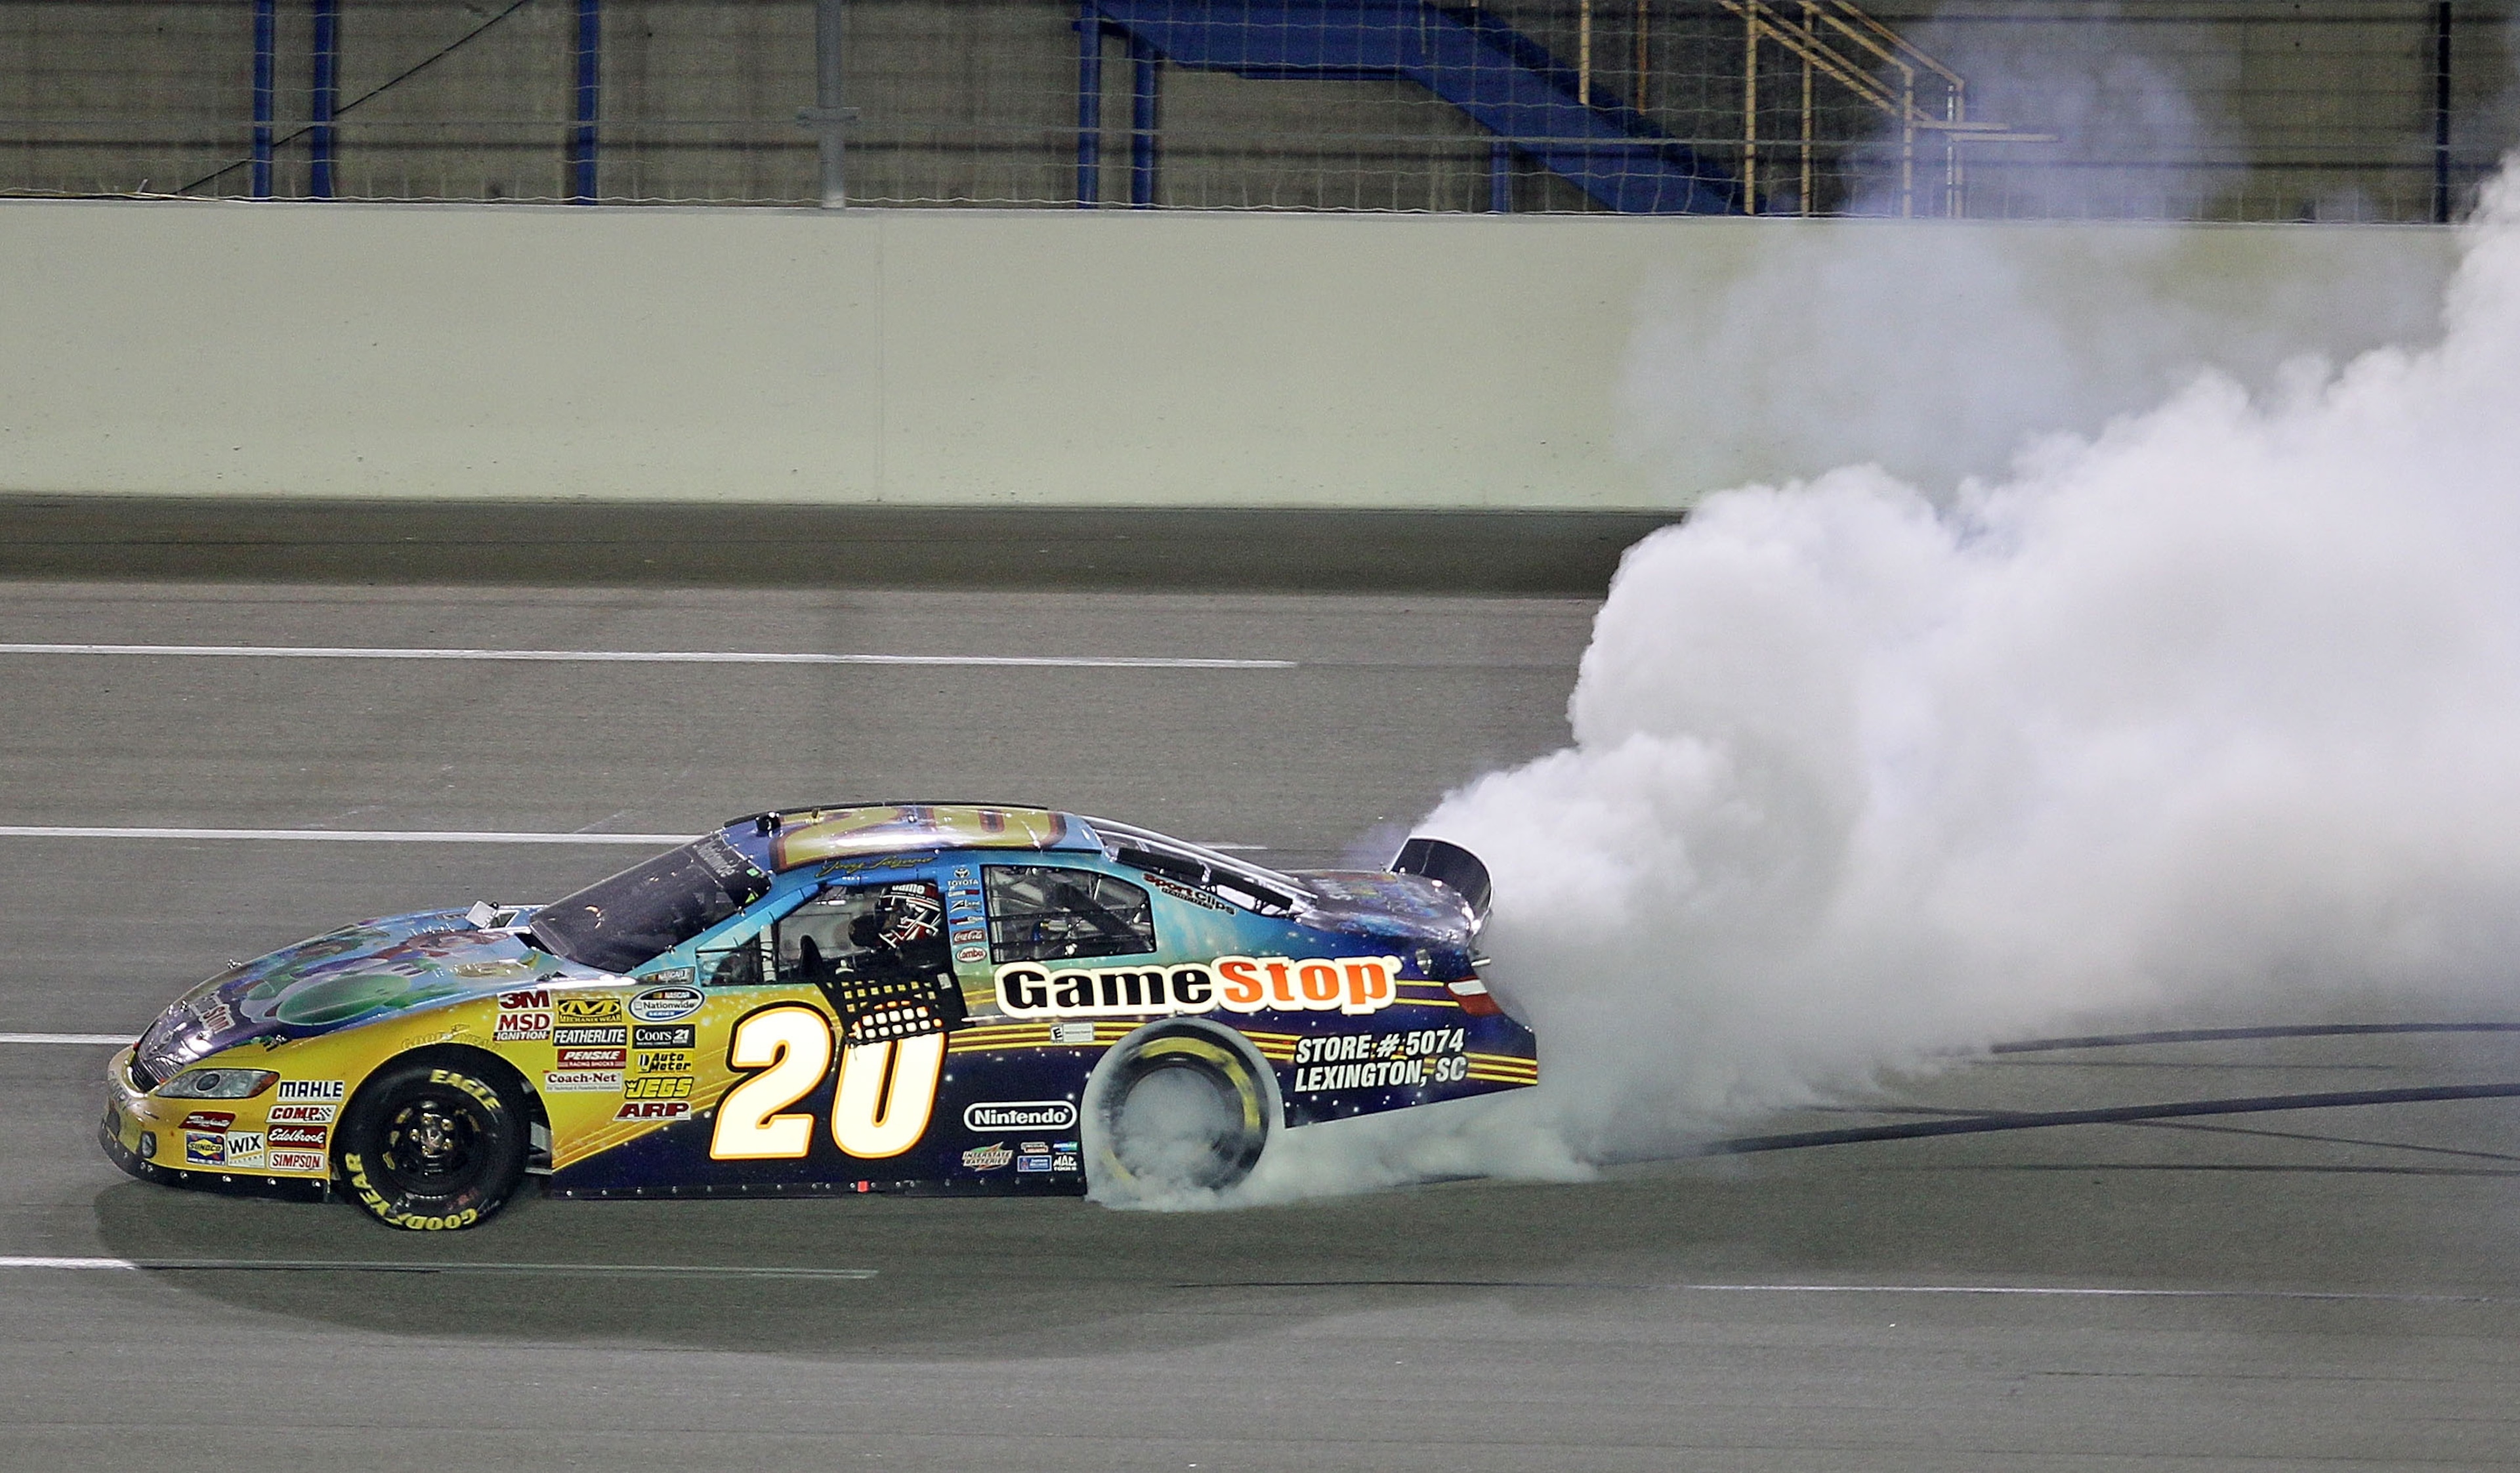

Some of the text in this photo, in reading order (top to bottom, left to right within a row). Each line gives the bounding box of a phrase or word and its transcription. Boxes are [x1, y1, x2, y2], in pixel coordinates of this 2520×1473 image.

[1143, 873, 1235, 916] Sport Clips
[998, 958, 1394, 1014] GameStop
[499, 990, 550, 1009] 3M
[499, 1014, 550, 1031] MSD
[497, 1031, 547, 1040] IGNITION
[554, 1029, 625, 1044] FEATHERLITE
[635, 1029, 690, 1042] Coors 21
[1053, 1027, 1063, 1039] E
[1296, 1028, 1465, 1063] STORE # 5074
[564, 1051, 621, 1060] PENSKE
[652, 1052, 685, 1061] Auto
[650, 1062, 692, 1071] Meter
[1295, 1056, 1467, 1092] LEXINGTON, SC
[547, 1072, 617, 1083] Coach-Net
[709, 1005, 947, 1161] 20
[279, 1081, 343, 1098] MAHLE
[430, 1069, 502, 1112] EAGLE
[626, 1077, 694, 1099] JEGS
[271, 1107, 320, 1119] COMP
[616, 1103, 689, 1117] ARP
[975, 1108, 1067, 1125] Nintendo
[268, 1128, 326, 1143] Edelbrock
[188, 1143, 221, 1152] SUNOCO
[228, 1134, 262, 1154] WIX
[272, 1153, 320, 1168] SIMPSON
[963, 1150, 1013, 1159] INTERSTATE
[963, 1157, 1009, 1166] BATTERIES
[1053, 1155, 1077, 1166] MAC
[345, 1151, 478, 1231] GOODYEAR
